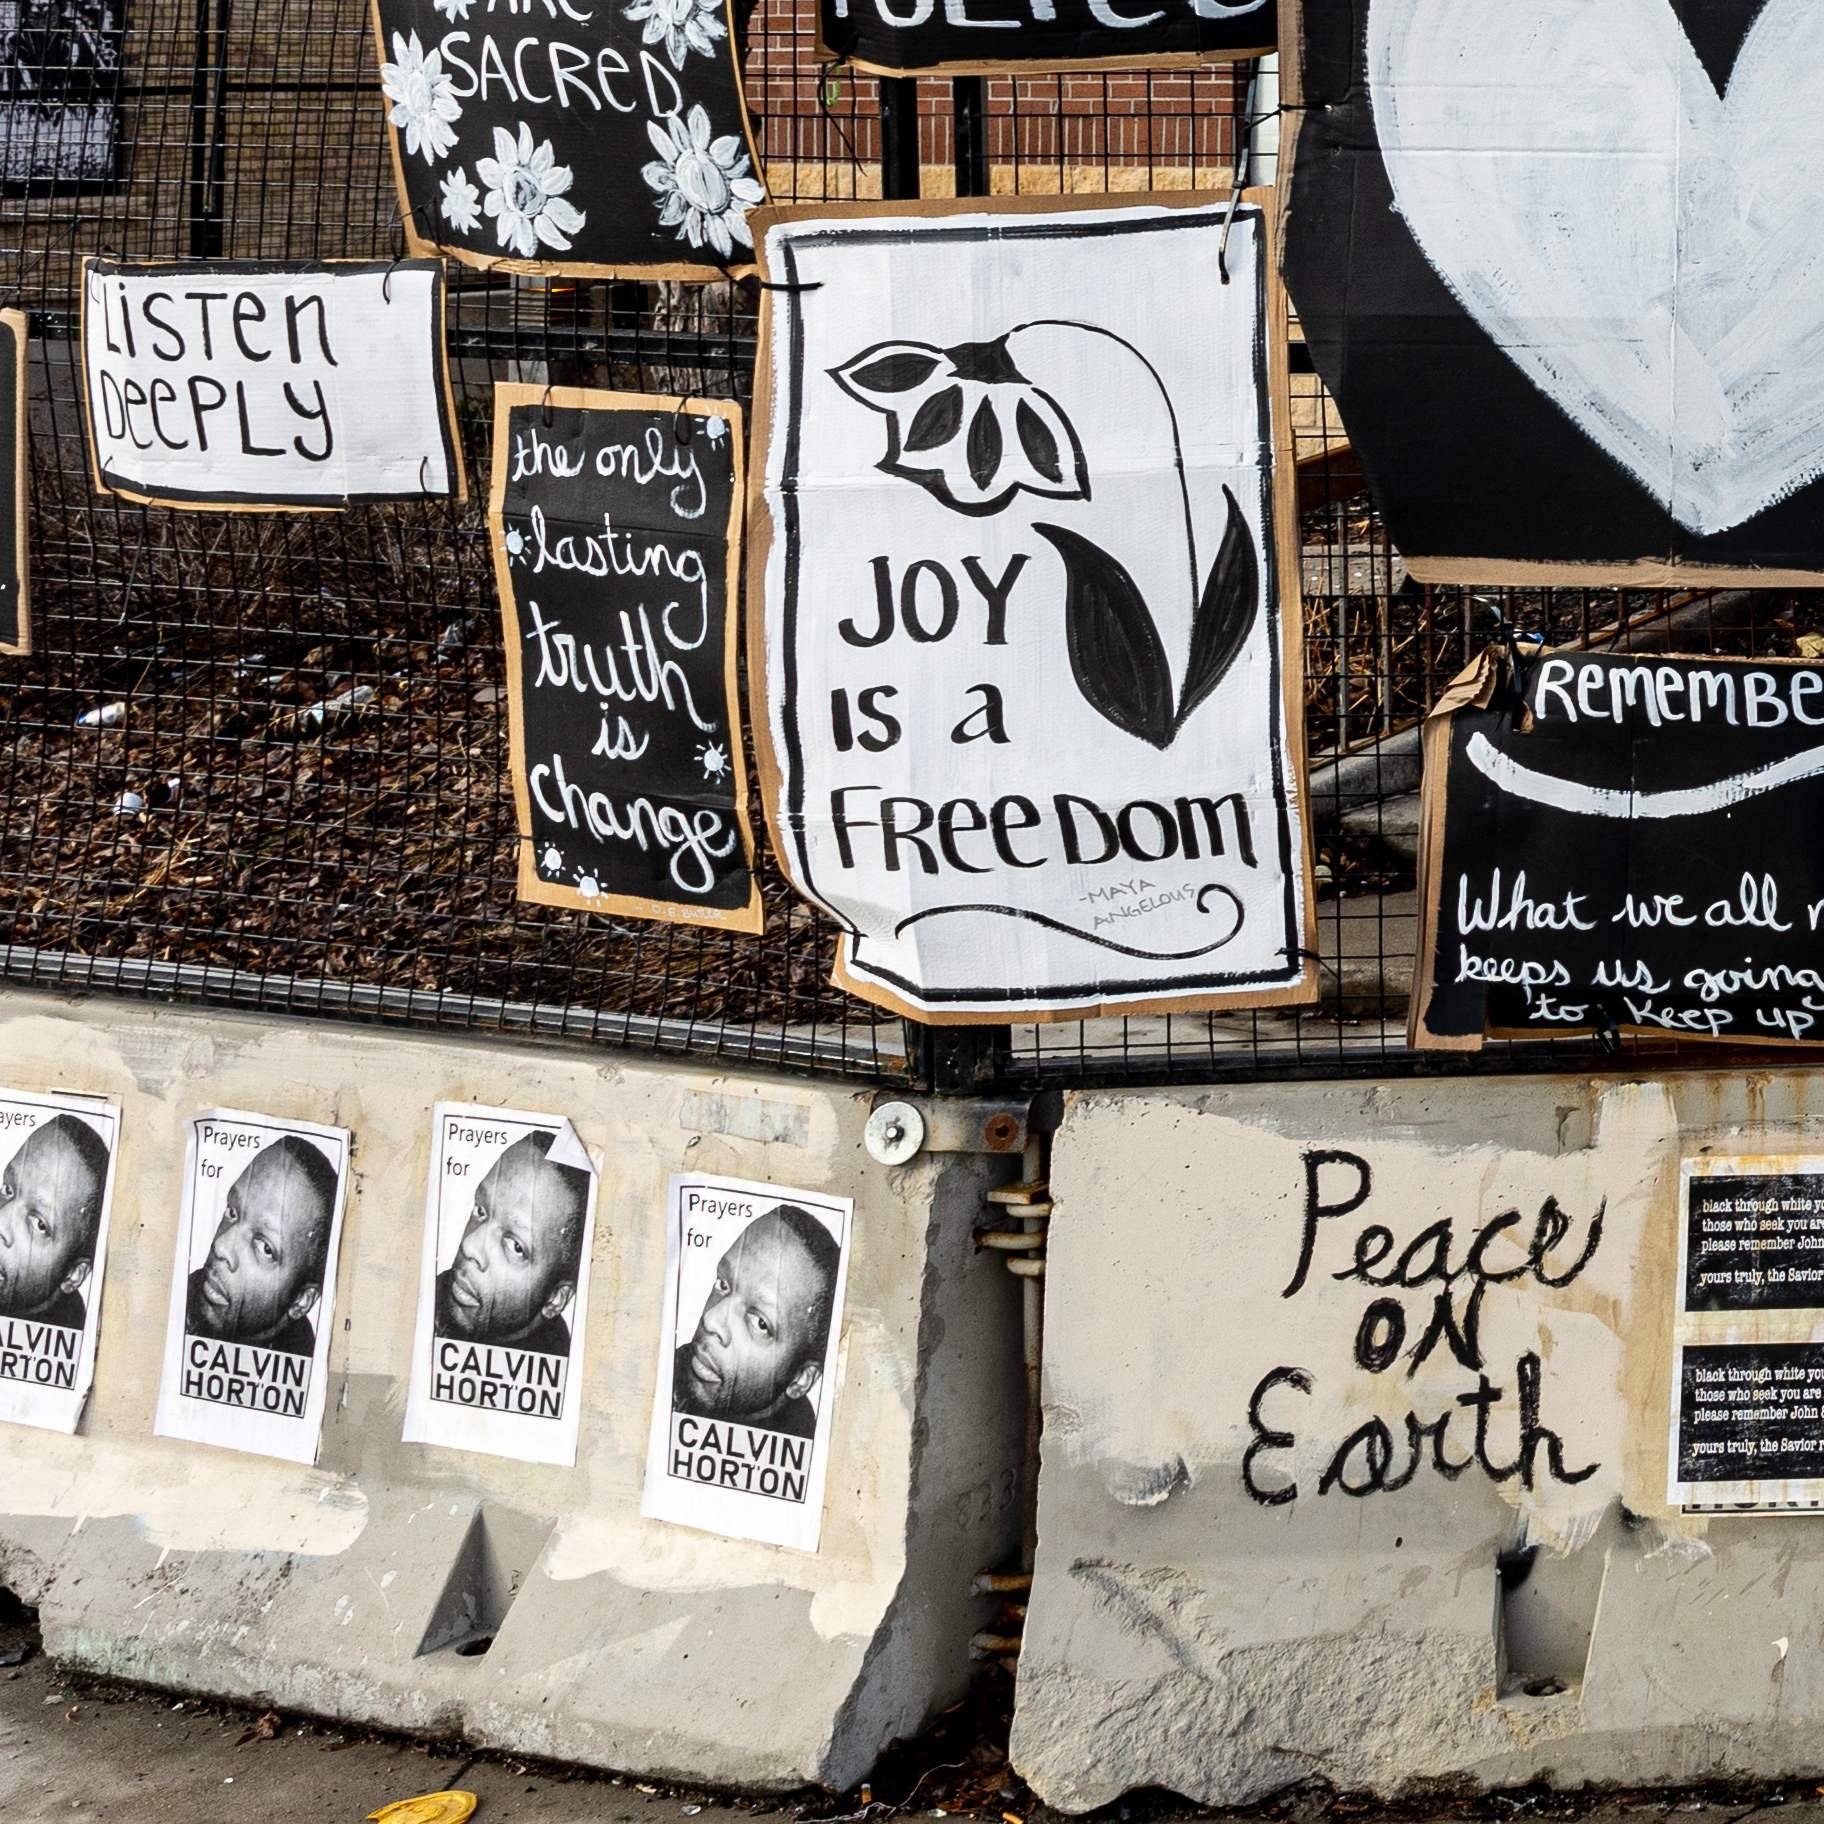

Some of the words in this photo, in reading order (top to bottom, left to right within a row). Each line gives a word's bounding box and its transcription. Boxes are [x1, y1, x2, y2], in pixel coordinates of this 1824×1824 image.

[511, 428, 585, 482] the
[596, 428, 706, 519] only
[532, 506, 708, 651] lasting
[838, 554, 1031, 647] JOY
[526, 601, 717, 732] truth
[591, 703, 649, 762] is
[950, 683, 1011, 746] a
[530, 754, 736, 892] change
[1093, 882, 1196, 931] ANGELOUS
[1457, 866, 1598, 936] What
[1611, 889, 1698, 929] we
[1703, 870, 1794, 934] all
[1454, 945, 1573, 1005] keeps
[1596, 956, 1656, 994] us
[1528, 987, 1591, 1025] to
[1753, 1002, 1820, 1040] up
[447, 1122, 509, 1147] Prayers
[445, 1156, 471, 1177] for
[688, 1192, 754, 1220] Prayers
[1280, 1147, 1608, 1300] Peace
[1702, 1218, 1732, 1232] those
[1735, 1218, 1758, 1231] who
[1759, 1217, 1785, 1231] seek
[1787, 1220, 1807, 1234] you
[1703, 1199, 1733, 1213] black
[1734, 1198, 1779, 1215] through
[1782, 1197, 1812, 1211] white
[686, 1229, 713, 1250] for
[1701, 1238, 1737, 1254] please
[1739, 1236, 1795, 1251] remember
[1797, 1236, 1824, 1250] John
[1699, 1271, 1733, 1287] yours
[1734, 1269, 1765, 1285] truly,
[1767, 1268, 1786, 1282] the
[1788, 1266, 1824, 1282] Savior
[439, 1341, 562, 1389] CALVIN
[435, 1372, 562, 1419] HORTON
[677, 1417, 807, 1472] CALVIN
[1241, 1349, 1602, 1507] Earth
[672, 1448, 806, 1501] HORTON
